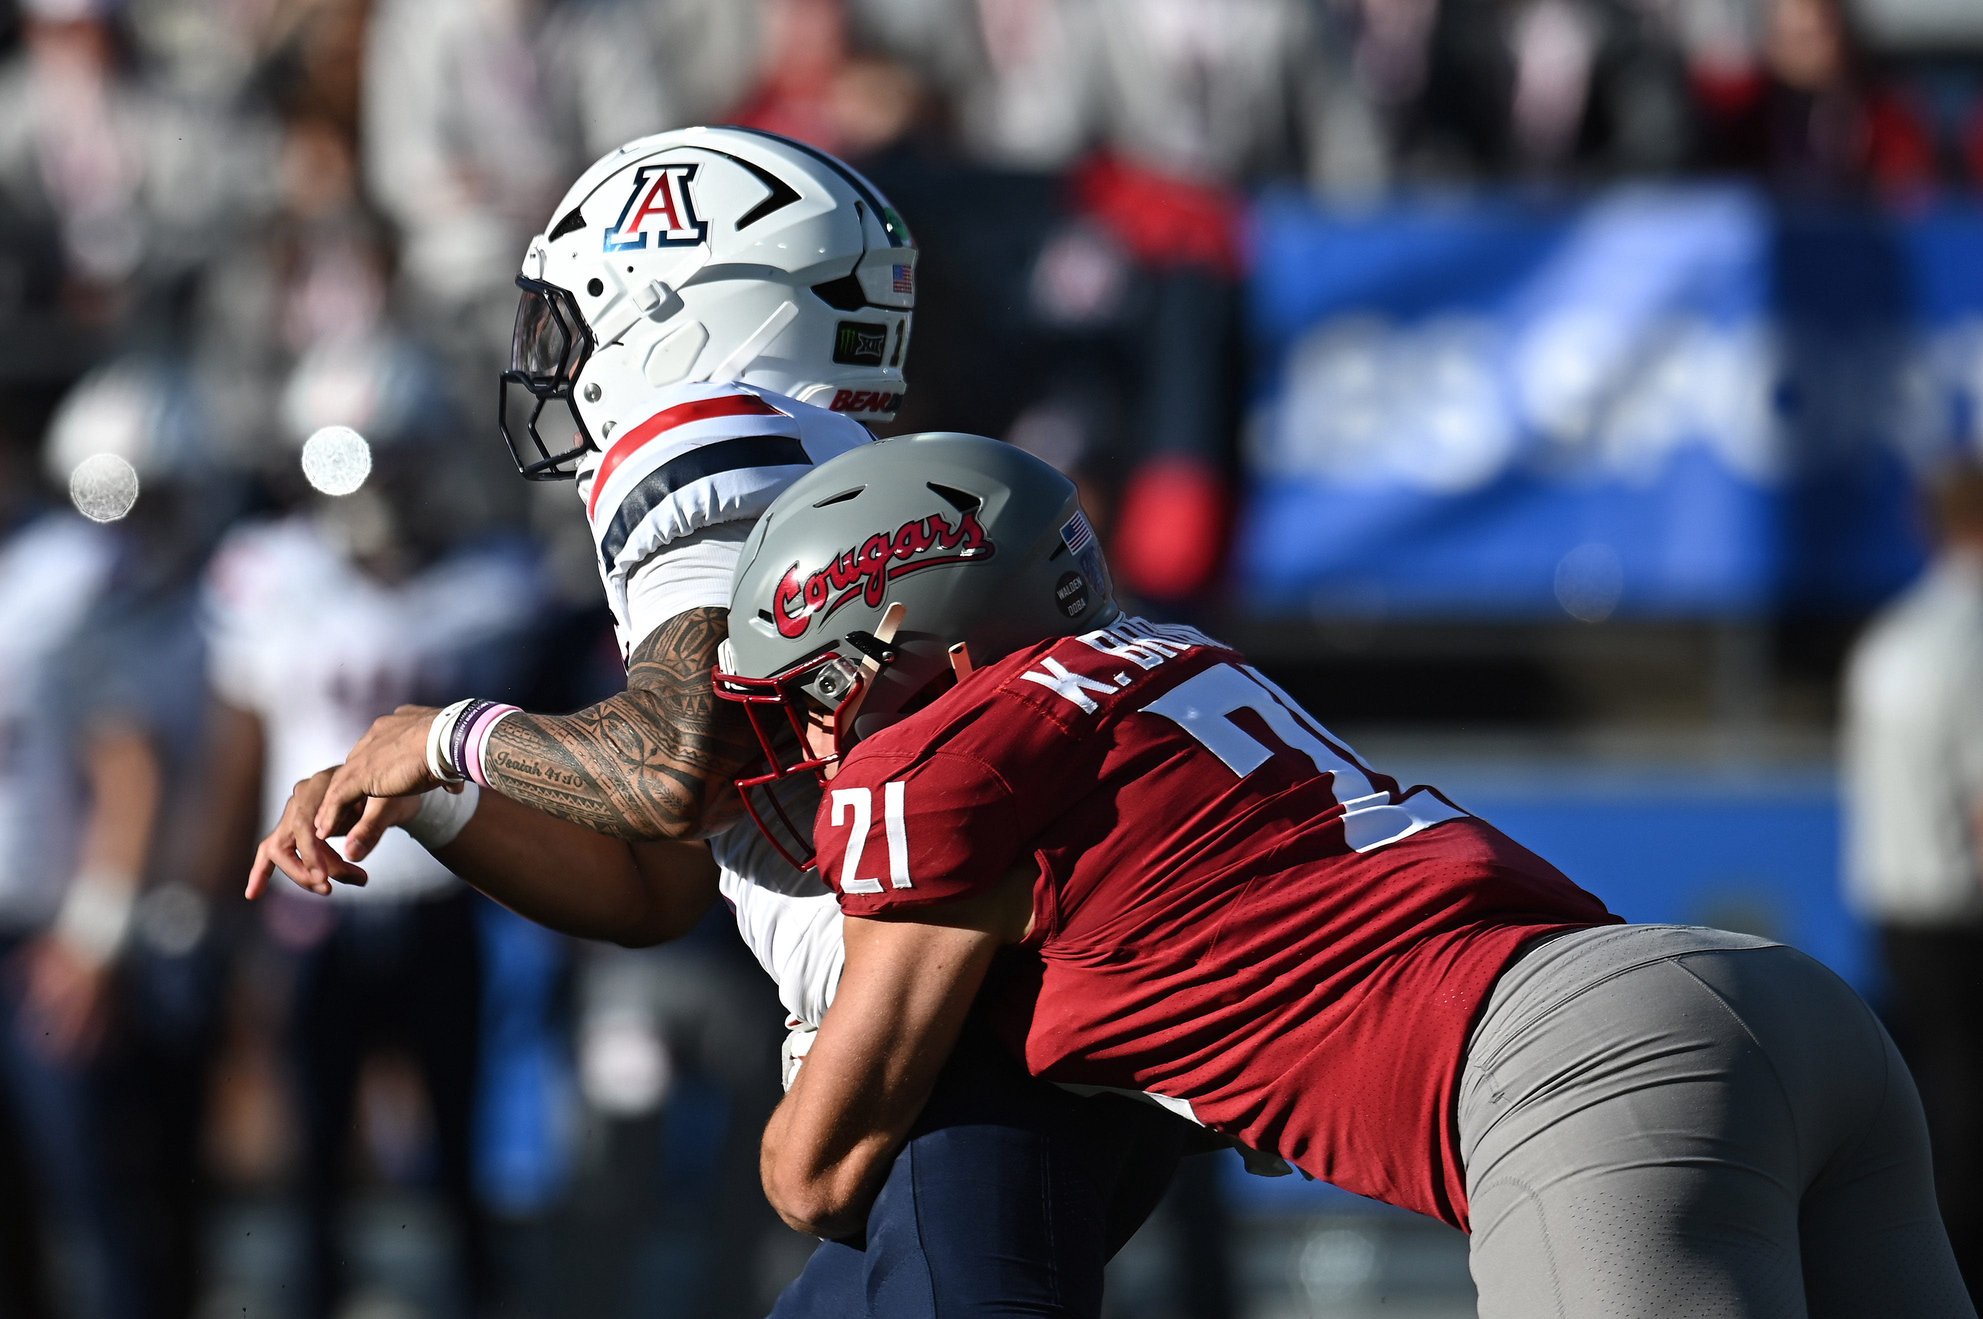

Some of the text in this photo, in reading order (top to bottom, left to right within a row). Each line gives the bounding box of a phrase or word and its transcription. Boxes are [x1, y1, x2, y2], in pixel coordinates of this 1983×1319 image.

[603, 163, 708, 253] A
[773, 511, 995, 638] Cougars
[1057, 576, 1083, 600] WALDEN
[1020, 656, 1132, 715] K.
[494, 751, 543, 777] Isaiah
[831, 781, 912, 894] 21
